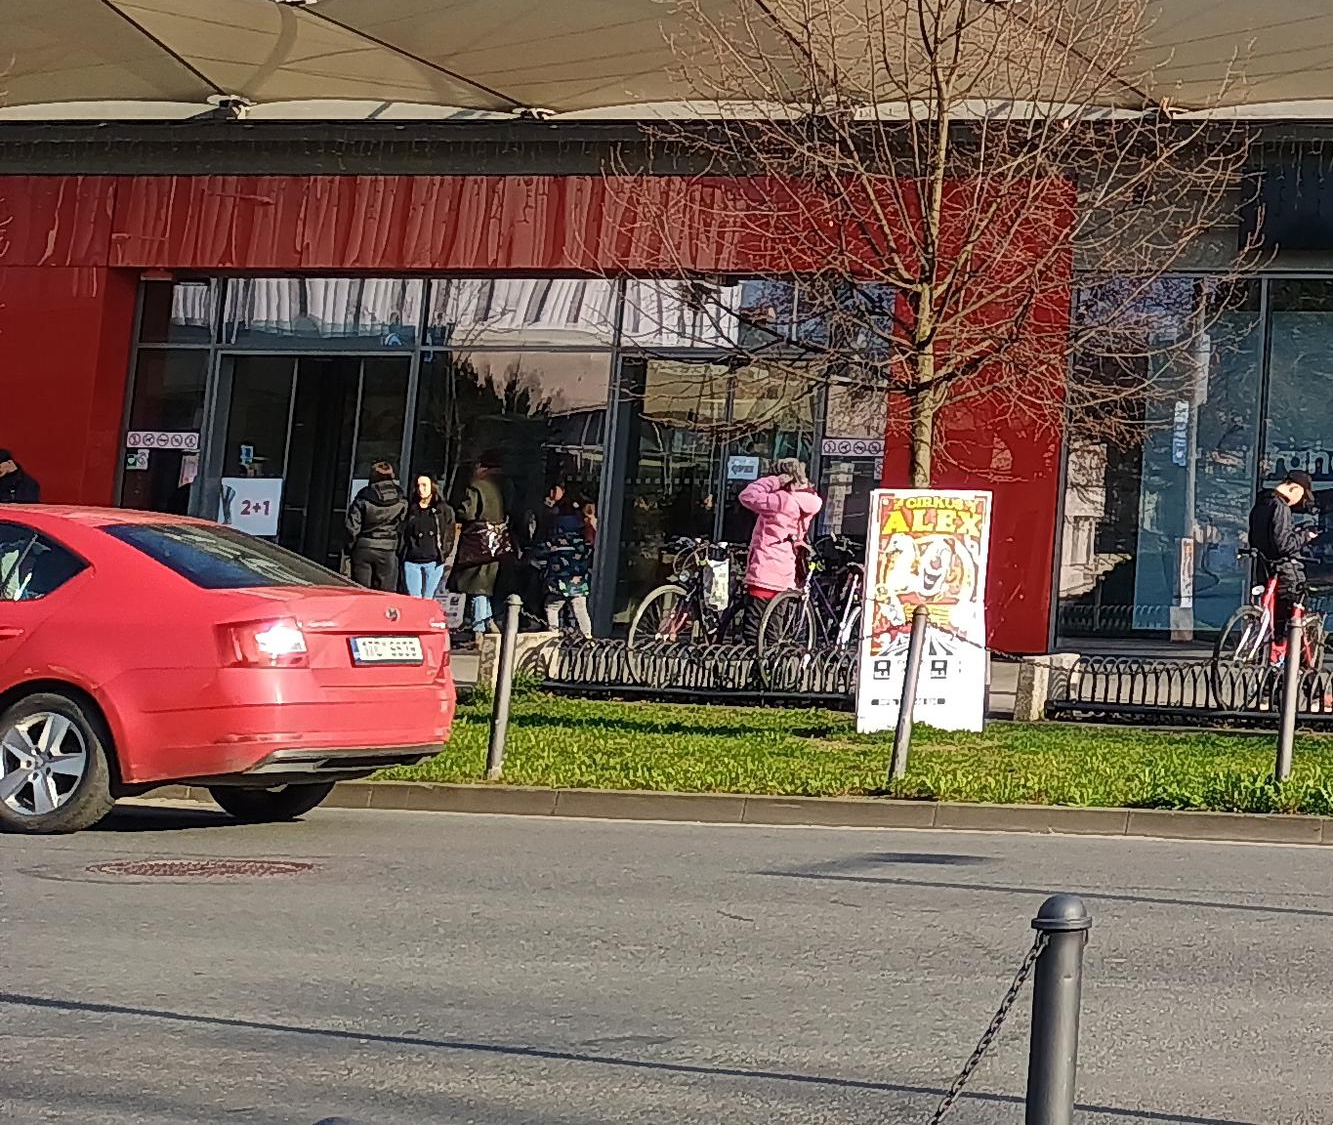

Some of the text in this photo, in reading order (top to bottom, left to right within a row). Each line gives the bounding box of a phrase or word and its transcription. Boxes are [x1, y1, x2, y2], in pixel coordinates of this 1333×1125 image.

[240, 499, 271, 516] 2+1
[906, 496, 964, 510] CIRKUS
[881, 509, 982, 538] ALEX
